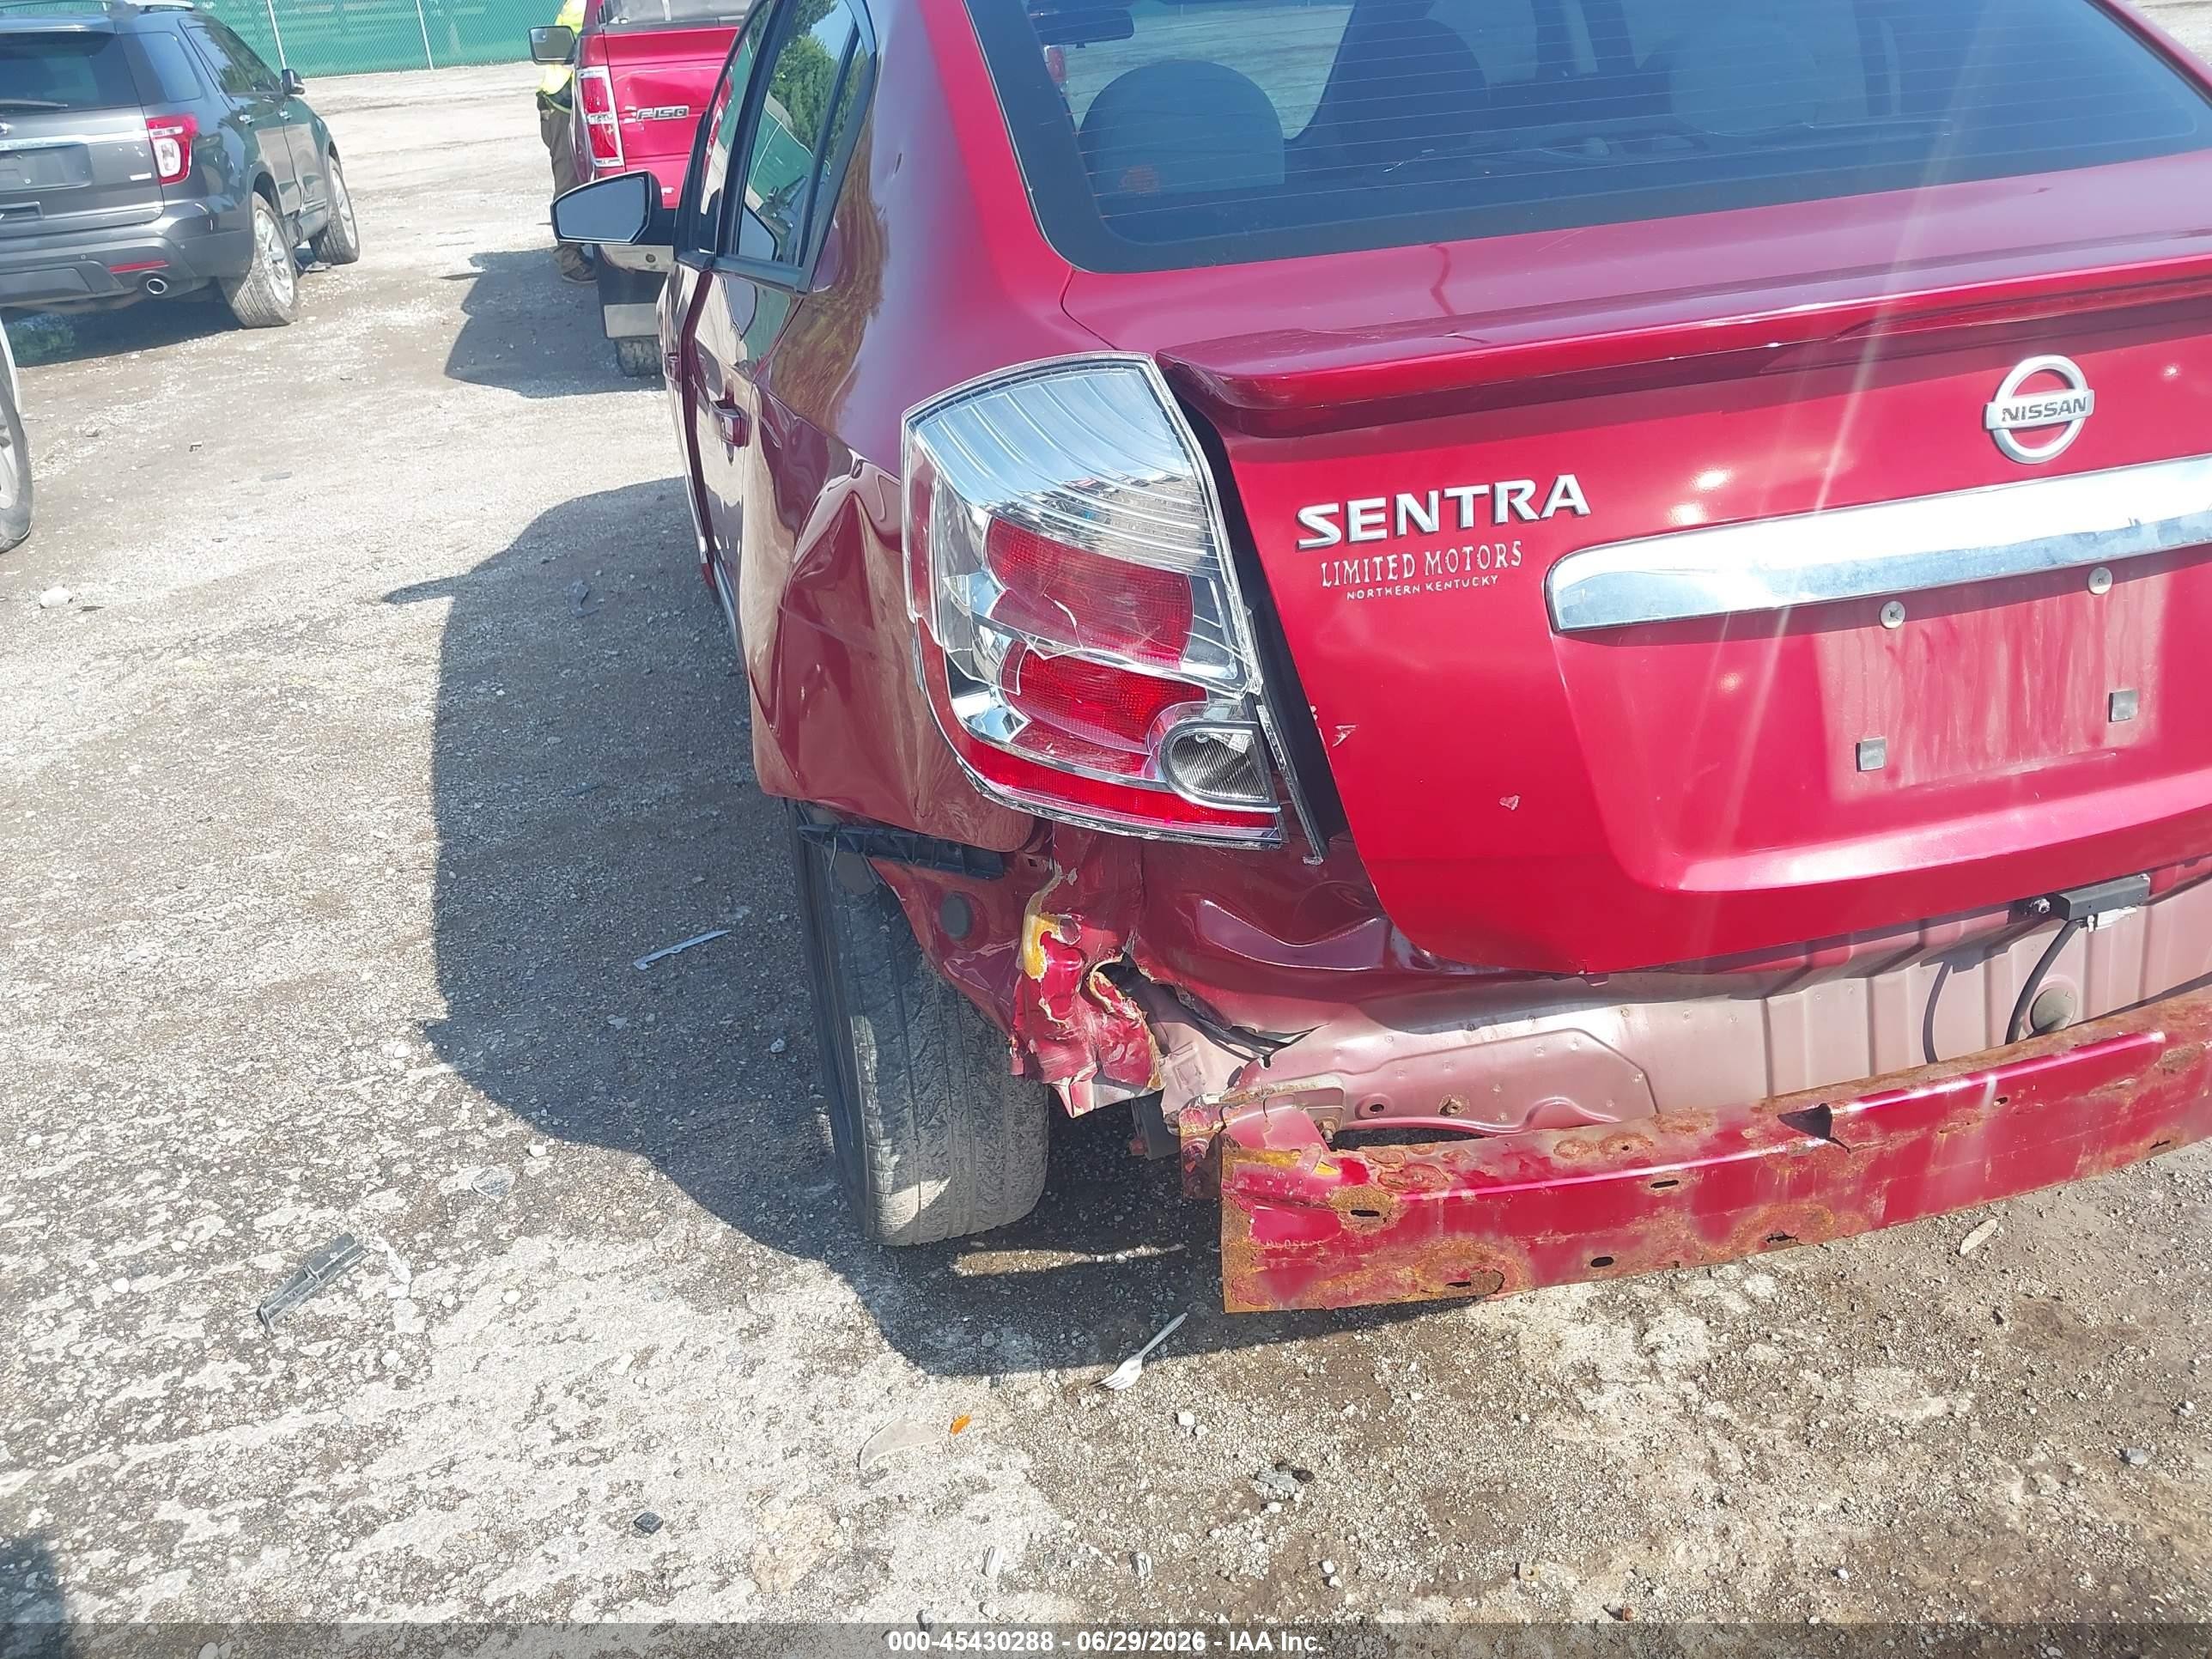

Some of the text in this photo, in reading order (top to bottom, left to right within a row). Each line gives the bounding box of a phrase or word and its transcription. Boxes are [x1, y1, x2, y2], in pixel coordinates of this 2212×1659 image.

[635, 106, 689, 122] F-150
[2002, 396, 2087, 422] NISSAN
[1297, 473, 1592, 550] SENTRA
[1321, 540, 1523, 588] LIMITED MOTORS
[1346, 574, 1499, 601] NORTHERN KENTUCKY
